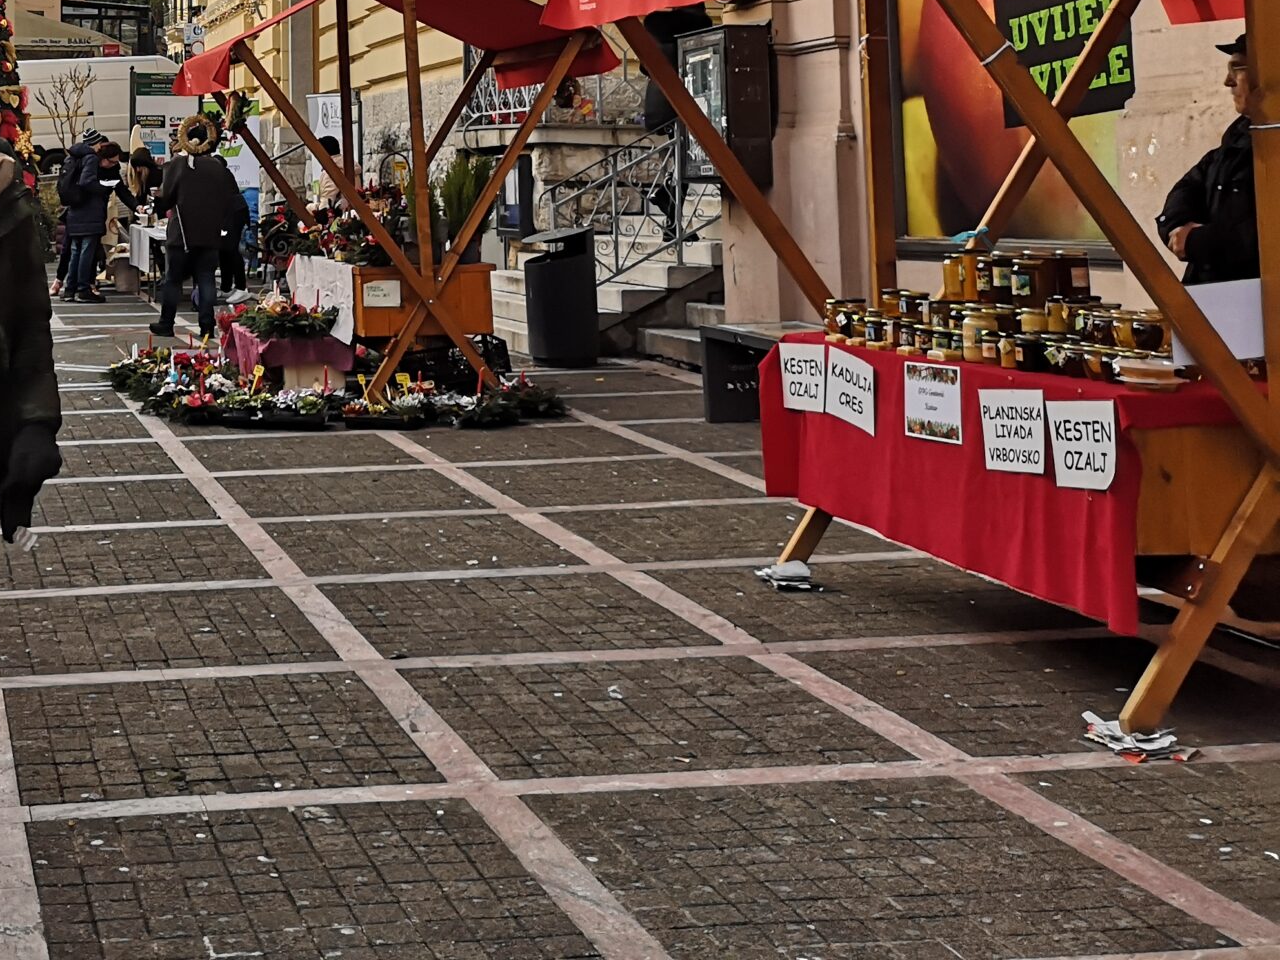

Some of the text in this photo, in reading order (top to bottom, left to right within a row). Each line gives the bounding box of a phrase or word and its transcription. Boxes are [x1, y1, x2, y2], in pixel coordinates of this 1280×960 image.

[784, 358, 822, 377] KESTEN
[831, 362, 872, 395] KADULJA
[789, 381, 819, 399] OZALJ
[839, 392, 863, 415] CRES
[983, 405, 1041, 421] PLANINSKA
[995, 424, 1032, 439] LIVADA
[1054, 420, 1111, 443] KESTEN
[989, 447, 1040, 464] VRBOVSKO
[1064, 450, 1107, 473] OZALJ
